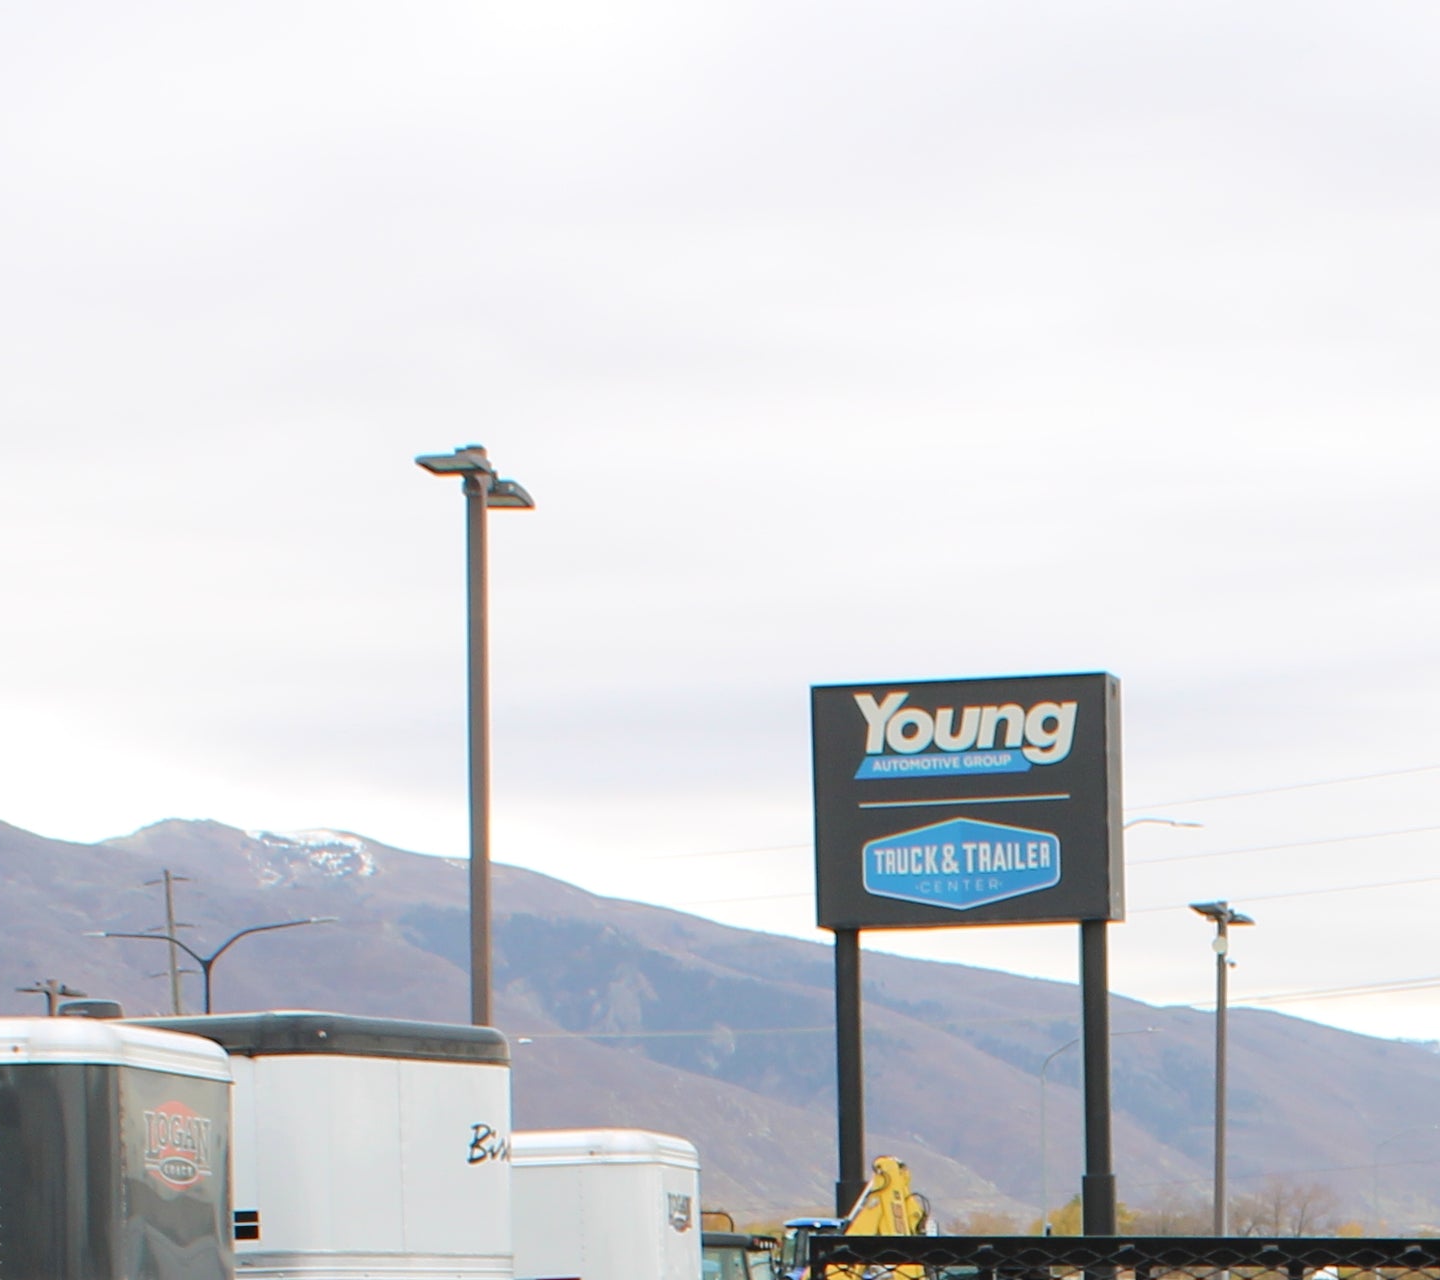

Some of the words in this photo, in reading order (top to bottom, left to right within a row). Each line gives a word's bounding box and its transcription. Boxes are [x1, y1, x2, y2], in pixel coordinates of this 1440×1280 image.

[854, 692, 1078, 765] Young
[872, 756, 960, 772] AUTOMOTIVE
[963, 754, 1012, 768] GROUP
[874, 844, 939, 875] TRUCK
[941, 843, 960, 875] &
[962, 841, 1051, 873] TRAILER
[144, 1110, 211, 1163] LOGAN
